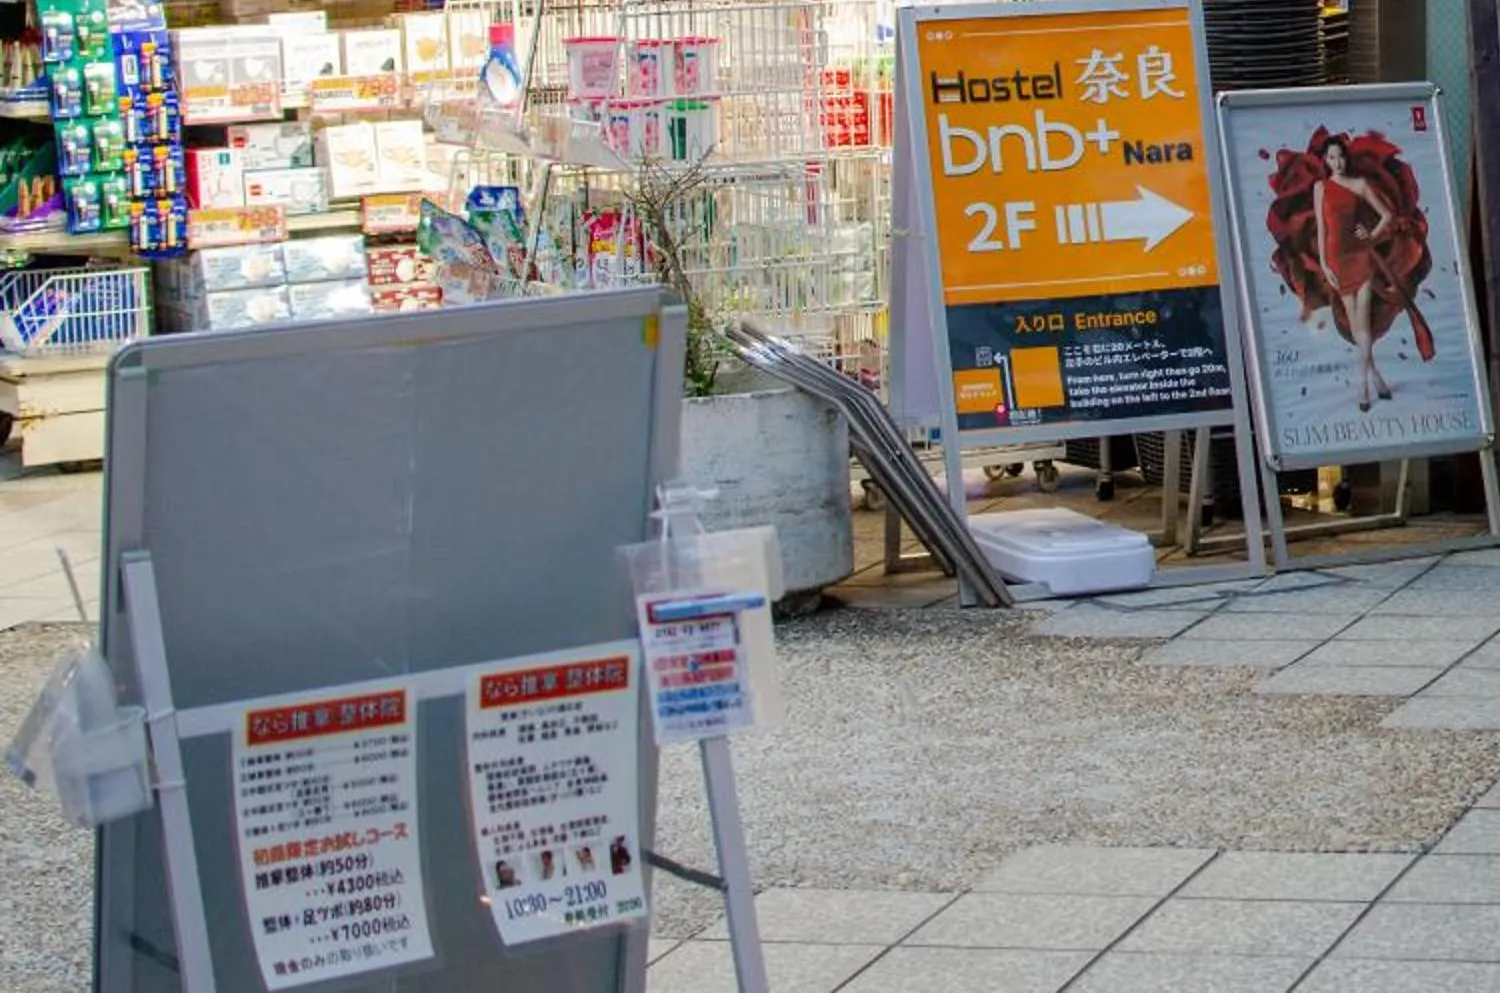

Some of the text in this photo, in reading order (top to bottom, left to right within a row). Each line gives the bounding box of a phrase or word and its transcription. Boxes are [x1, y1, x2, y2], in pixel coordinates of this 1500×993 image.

[931, 45, 1185, 104] Hostel 奈良
[937, 109, 1193, 177] bnb+ Nara
[964, 200, 1037, 252] 2F
[1015, 309, 1157, 334] 入り口 Entrance
[1283, 410, 1475, 448] SLIM BEAUTY HOUSE
